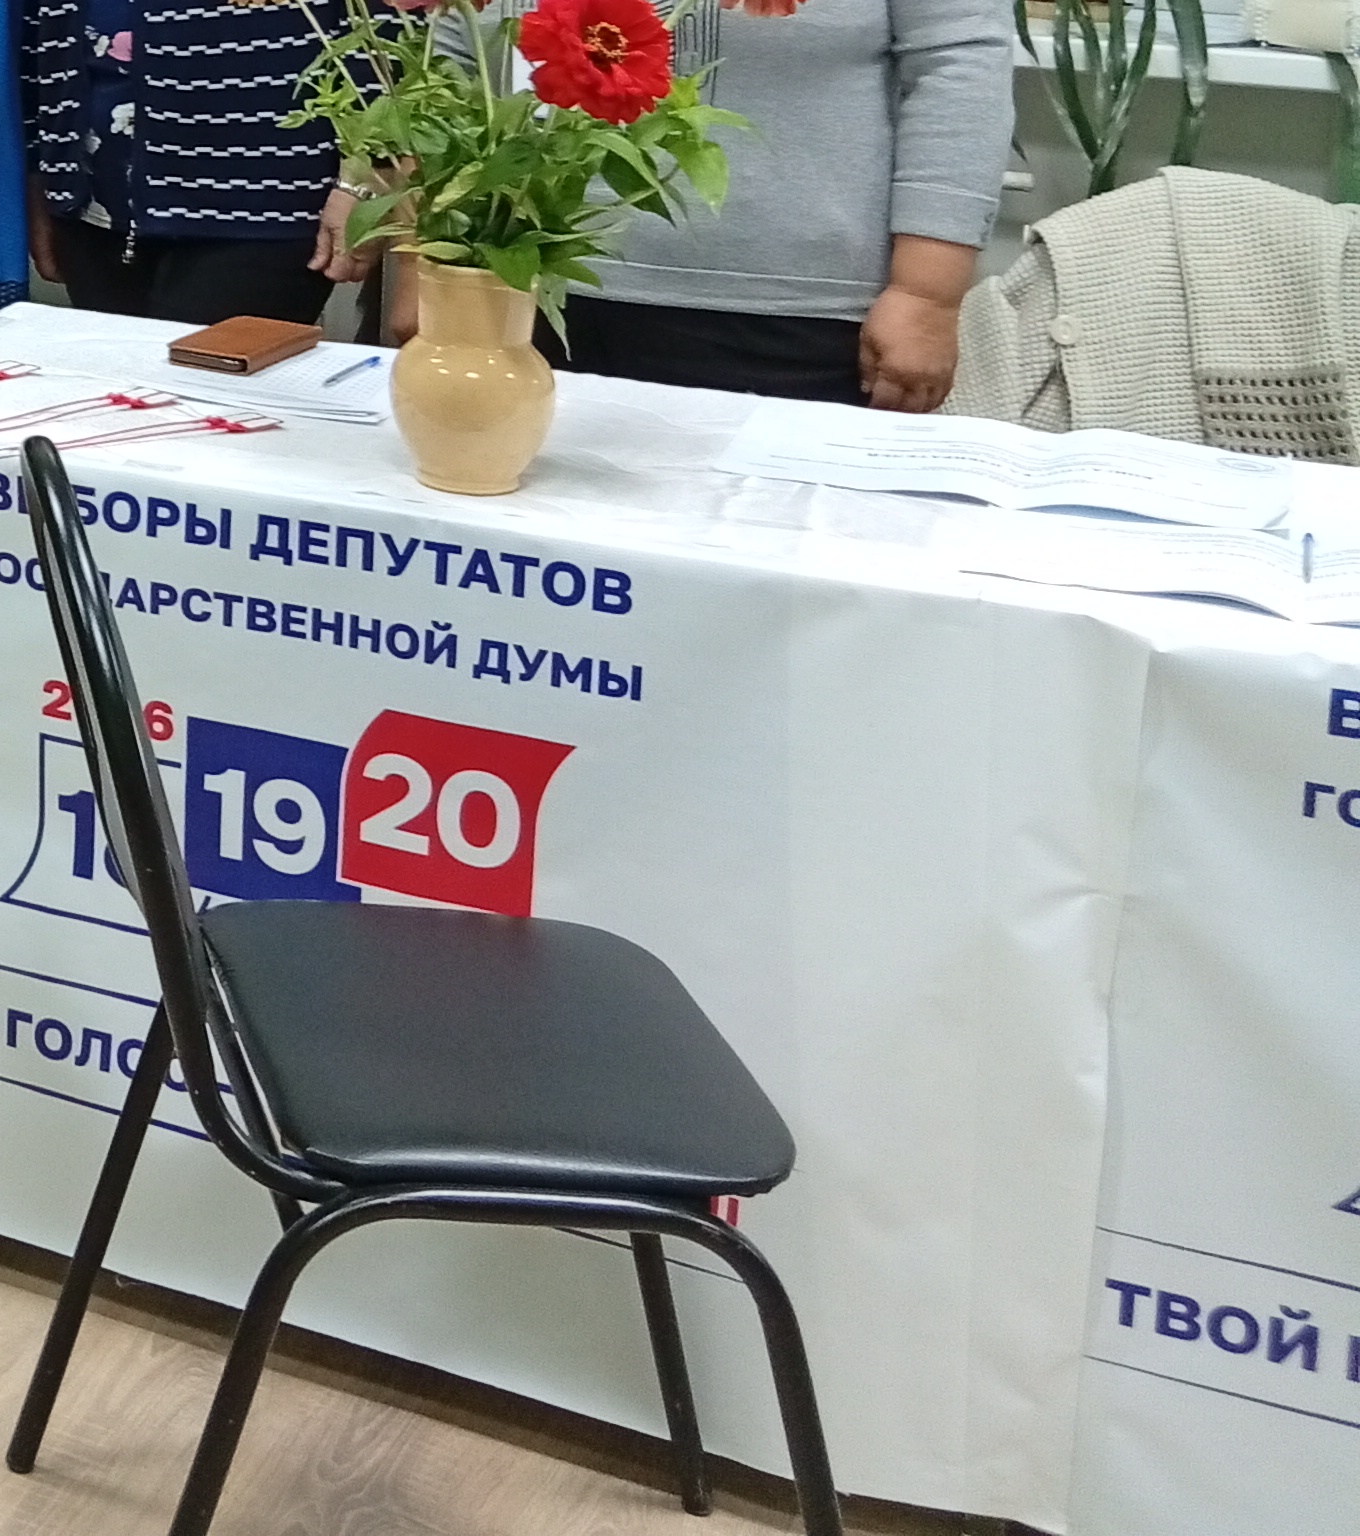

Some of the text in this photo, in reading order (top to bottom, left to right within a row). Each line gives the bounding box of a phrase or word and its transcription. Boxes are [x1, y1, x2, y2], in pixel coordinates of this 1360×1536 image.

[249, 514, 633, 615] ДЕПУТАТОВ
[41, 680, 174, 741] 26
[472, 639, 643, 702] ДУМЫ
[58, 790, 128, 889] 1
[203, 768, 326, 875] 19
[359, 753, 521, 868] 20
[1105, 1277, 1319, 1372] ТВОЙ
